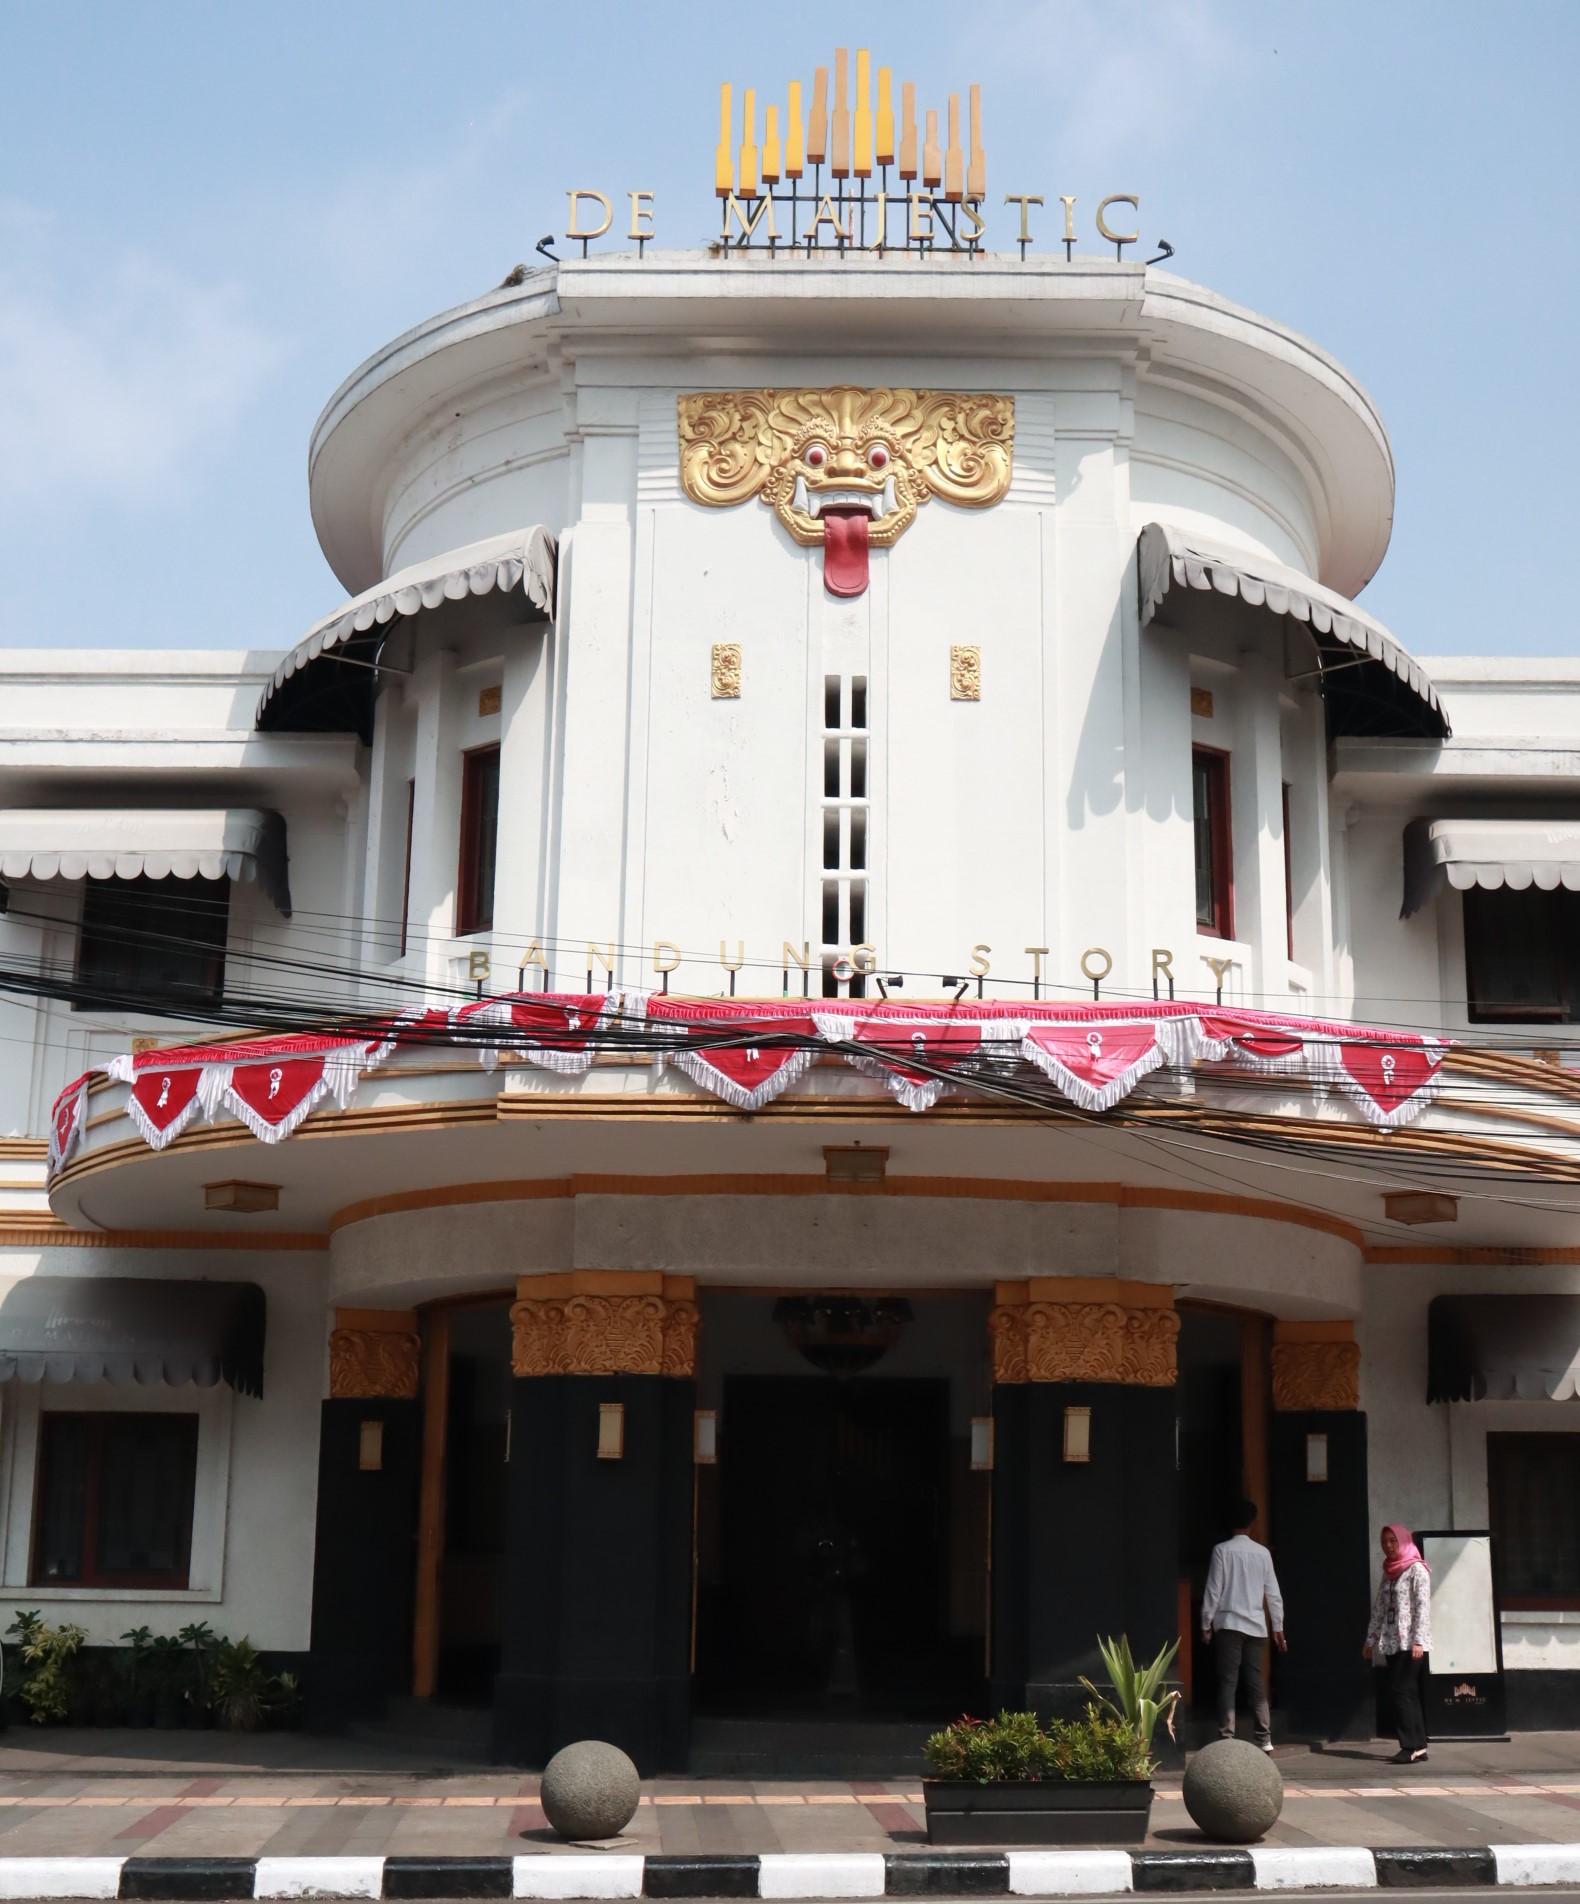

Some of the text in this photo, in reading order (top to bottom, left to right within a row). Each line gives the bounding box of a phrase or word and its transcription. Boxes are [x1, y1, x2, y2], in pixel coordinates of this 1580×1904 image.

[565, 190, 1140, 250] DE MAJESTIC
[469, 938, 1232, 988] BANDUNG STORY
